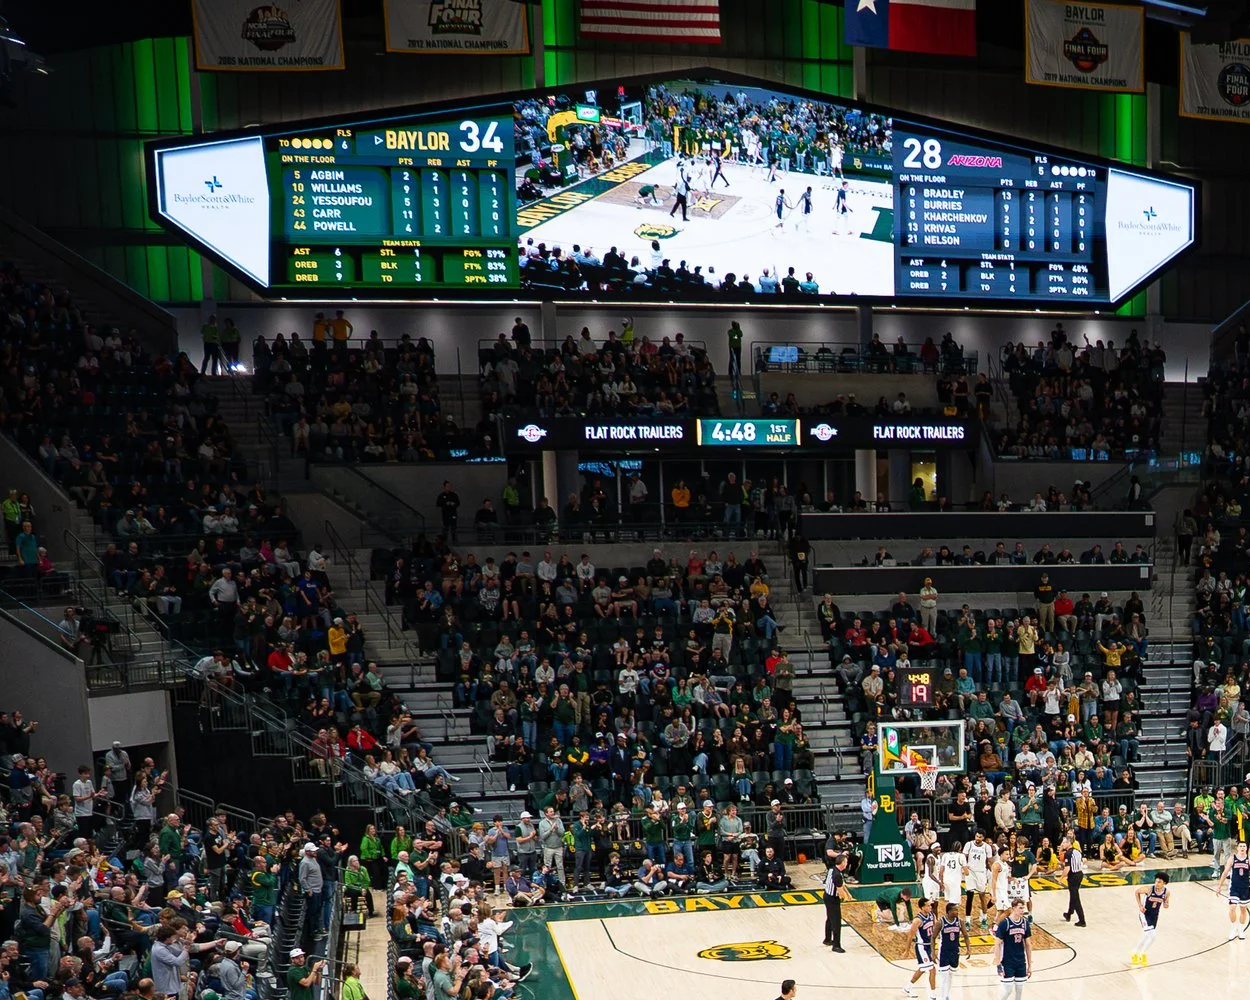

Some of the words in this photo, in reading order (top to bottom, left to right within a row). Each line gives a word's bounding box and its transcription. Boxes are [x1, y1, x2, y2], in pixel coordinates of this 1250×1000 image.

[1065, 5, 1105, 21] BAYLOR
[407, 39, 424, 48] 2012
[426, 39, 463, 49] NATIONAL
[464, 40, 508, 49] CHAMPIONS
[1065, 44, 1086, 54] FINAL
[1087, 45, 1107, 56] FOUR
[238, 57, 275, 66] NATIONAL
[277, 57, 323, 66] CHAMPIONS
[1059, 75, 1089, 85] NATIONAL
[1090, 77, 1127, 87] CHAMPIONS
[1226, 74, 1249, 85] FINAL
[1226, 84, 1249, 95] FOUR
[1211, 108, 1241, 118] NATIONAL
[336, 129, 352, 137] FLS
[385, 130, 450, 151] BAYLOR
[459, 120, 504, 153] 34
[279, 139, 290, 147] TO
[341, 140, 349, 150] 6
[903, 138, 942, 169] 28
[947, 155, 1003, 168] ARIZONA
[281, 155, 293, 163] ON
[294, 156, 310, 164] THE
[310, 156, 336, 164] FLOOR
[1035, 156, 1047, 164] FLS
[294, 170, 301, 179] 5
[310, 171, 345, 181] AGBIM
[1038, 167, 1044, 176] 5
[1087, 169, 1096, 177] TO
[900, 174, 910, 182] ON
[910, 175, 924, 183] THE
[292, 183, 305, 192] 10
[310, 183, 363, 193] WILLIAMS
[1000, 179, 1013, 187] PTS
[1025, 180, 1038, 188] REB
[1050, 181, 1063, 189] AST
[1076, 182, 1086, 190] PF
[923, 189, 965, 199] BRADLEY
[292, 195, 305, 205] 24
[311, 195, 373, 206] YESSOUFOU
[923, 200, 962, 210] BURRIES
[293, 209, 306, 218] 43
[312, 208, 342, 218] CARR
[923, 212, 988, 224] KHARCHENKOV
[293, 221, 306, 230] 44
[313, 221, 357, 231] POWELL
[908, 223, 918, 232] 13
[923, 224, 957, 234] KRIVAS
[908, 234, 918, 243] 21
[923, 235, 960, 246] NELSON
[486, 250, 506, 258] 59%
[295, 261, 318, 269] OREB
[380, 262, 398, 270] BLK
[487, 262, 506, 271] 83%
[910, 259, 924, 267] AST
[585, 426, 609, 439] FLAT
[610, 426, 636, 439] ROCK
[637, 425, 683, 439] TRAILERS
[712, 422, 756, 441] 4:48
[770, 424, 787, 433] 1ST
[873, 426, 896, 439] FLAT
[896, 426, 921, 439] ROCK
[922, 426, 964, 439] TRAILERS
[766, 433, 791, 442] HALF
[908, 673, 930, 684] 4:48
[911, 685, 927, 702] 19
[880, 795, 895, 813] BU
[947, 860, 956, 870] 43
[644, 891, 826, 914] BAYLO
